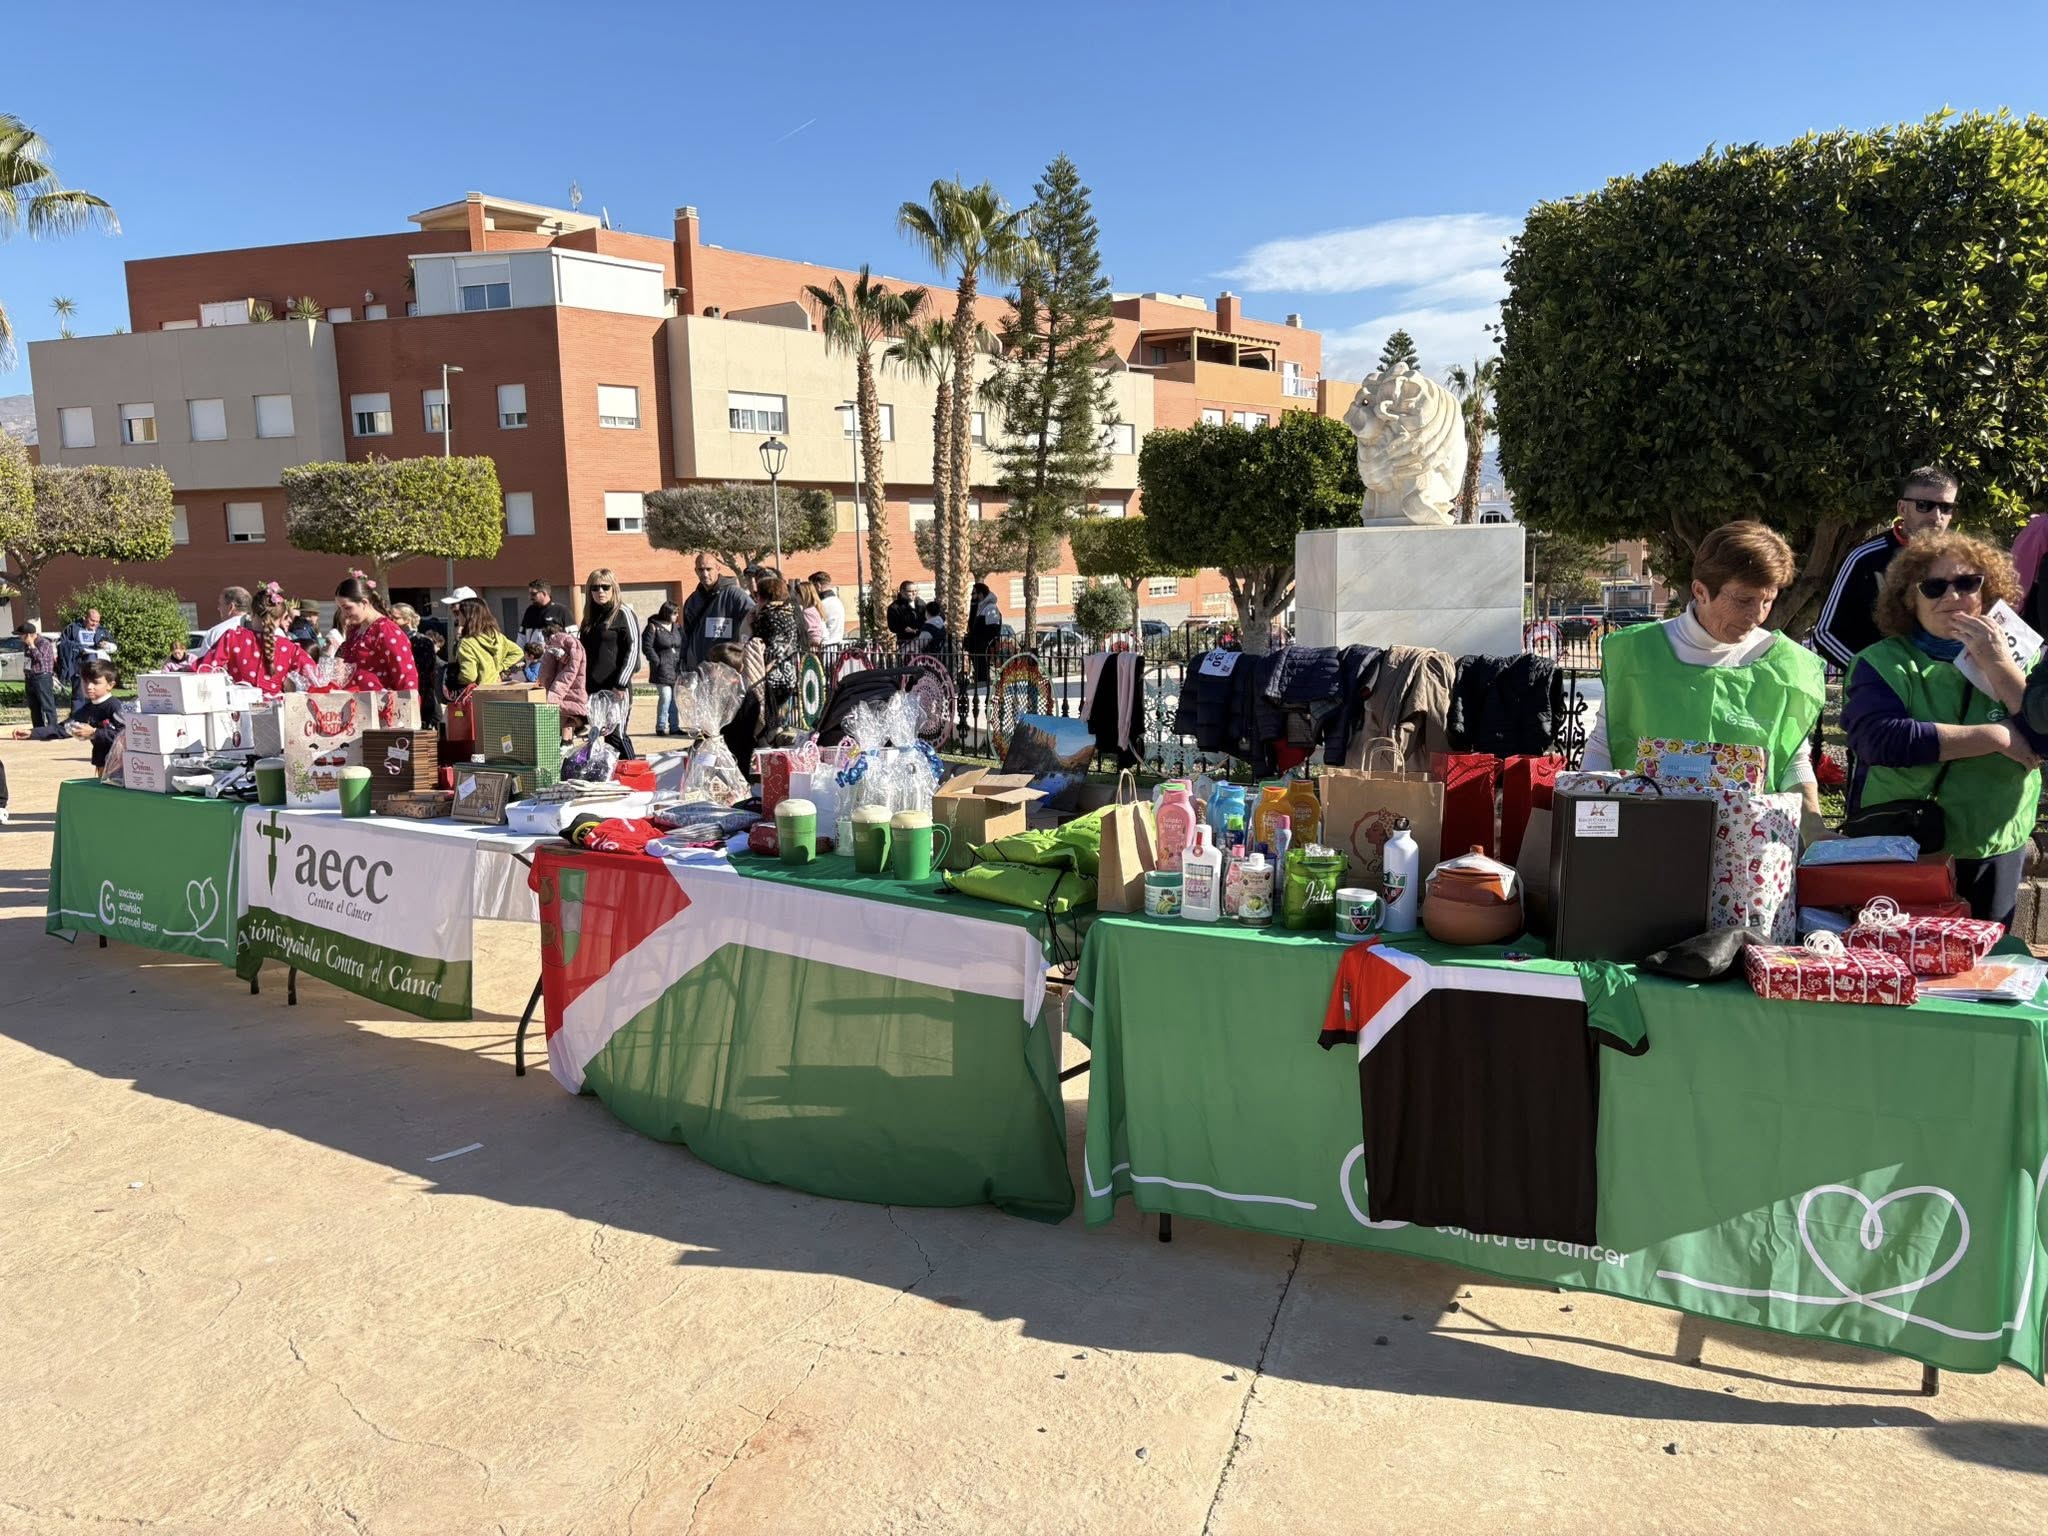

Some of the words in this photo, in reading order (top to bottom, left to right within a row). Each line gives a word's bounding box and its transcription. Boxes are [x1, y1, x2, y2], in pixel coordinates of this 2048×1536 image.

[294, 844, 393, 905] aecc
[307, 891, 334, 912] Contra
[336, 899, 345, 914] el
[326, 944, 365, 979] Contra
[371, 960, 383, 985] el
